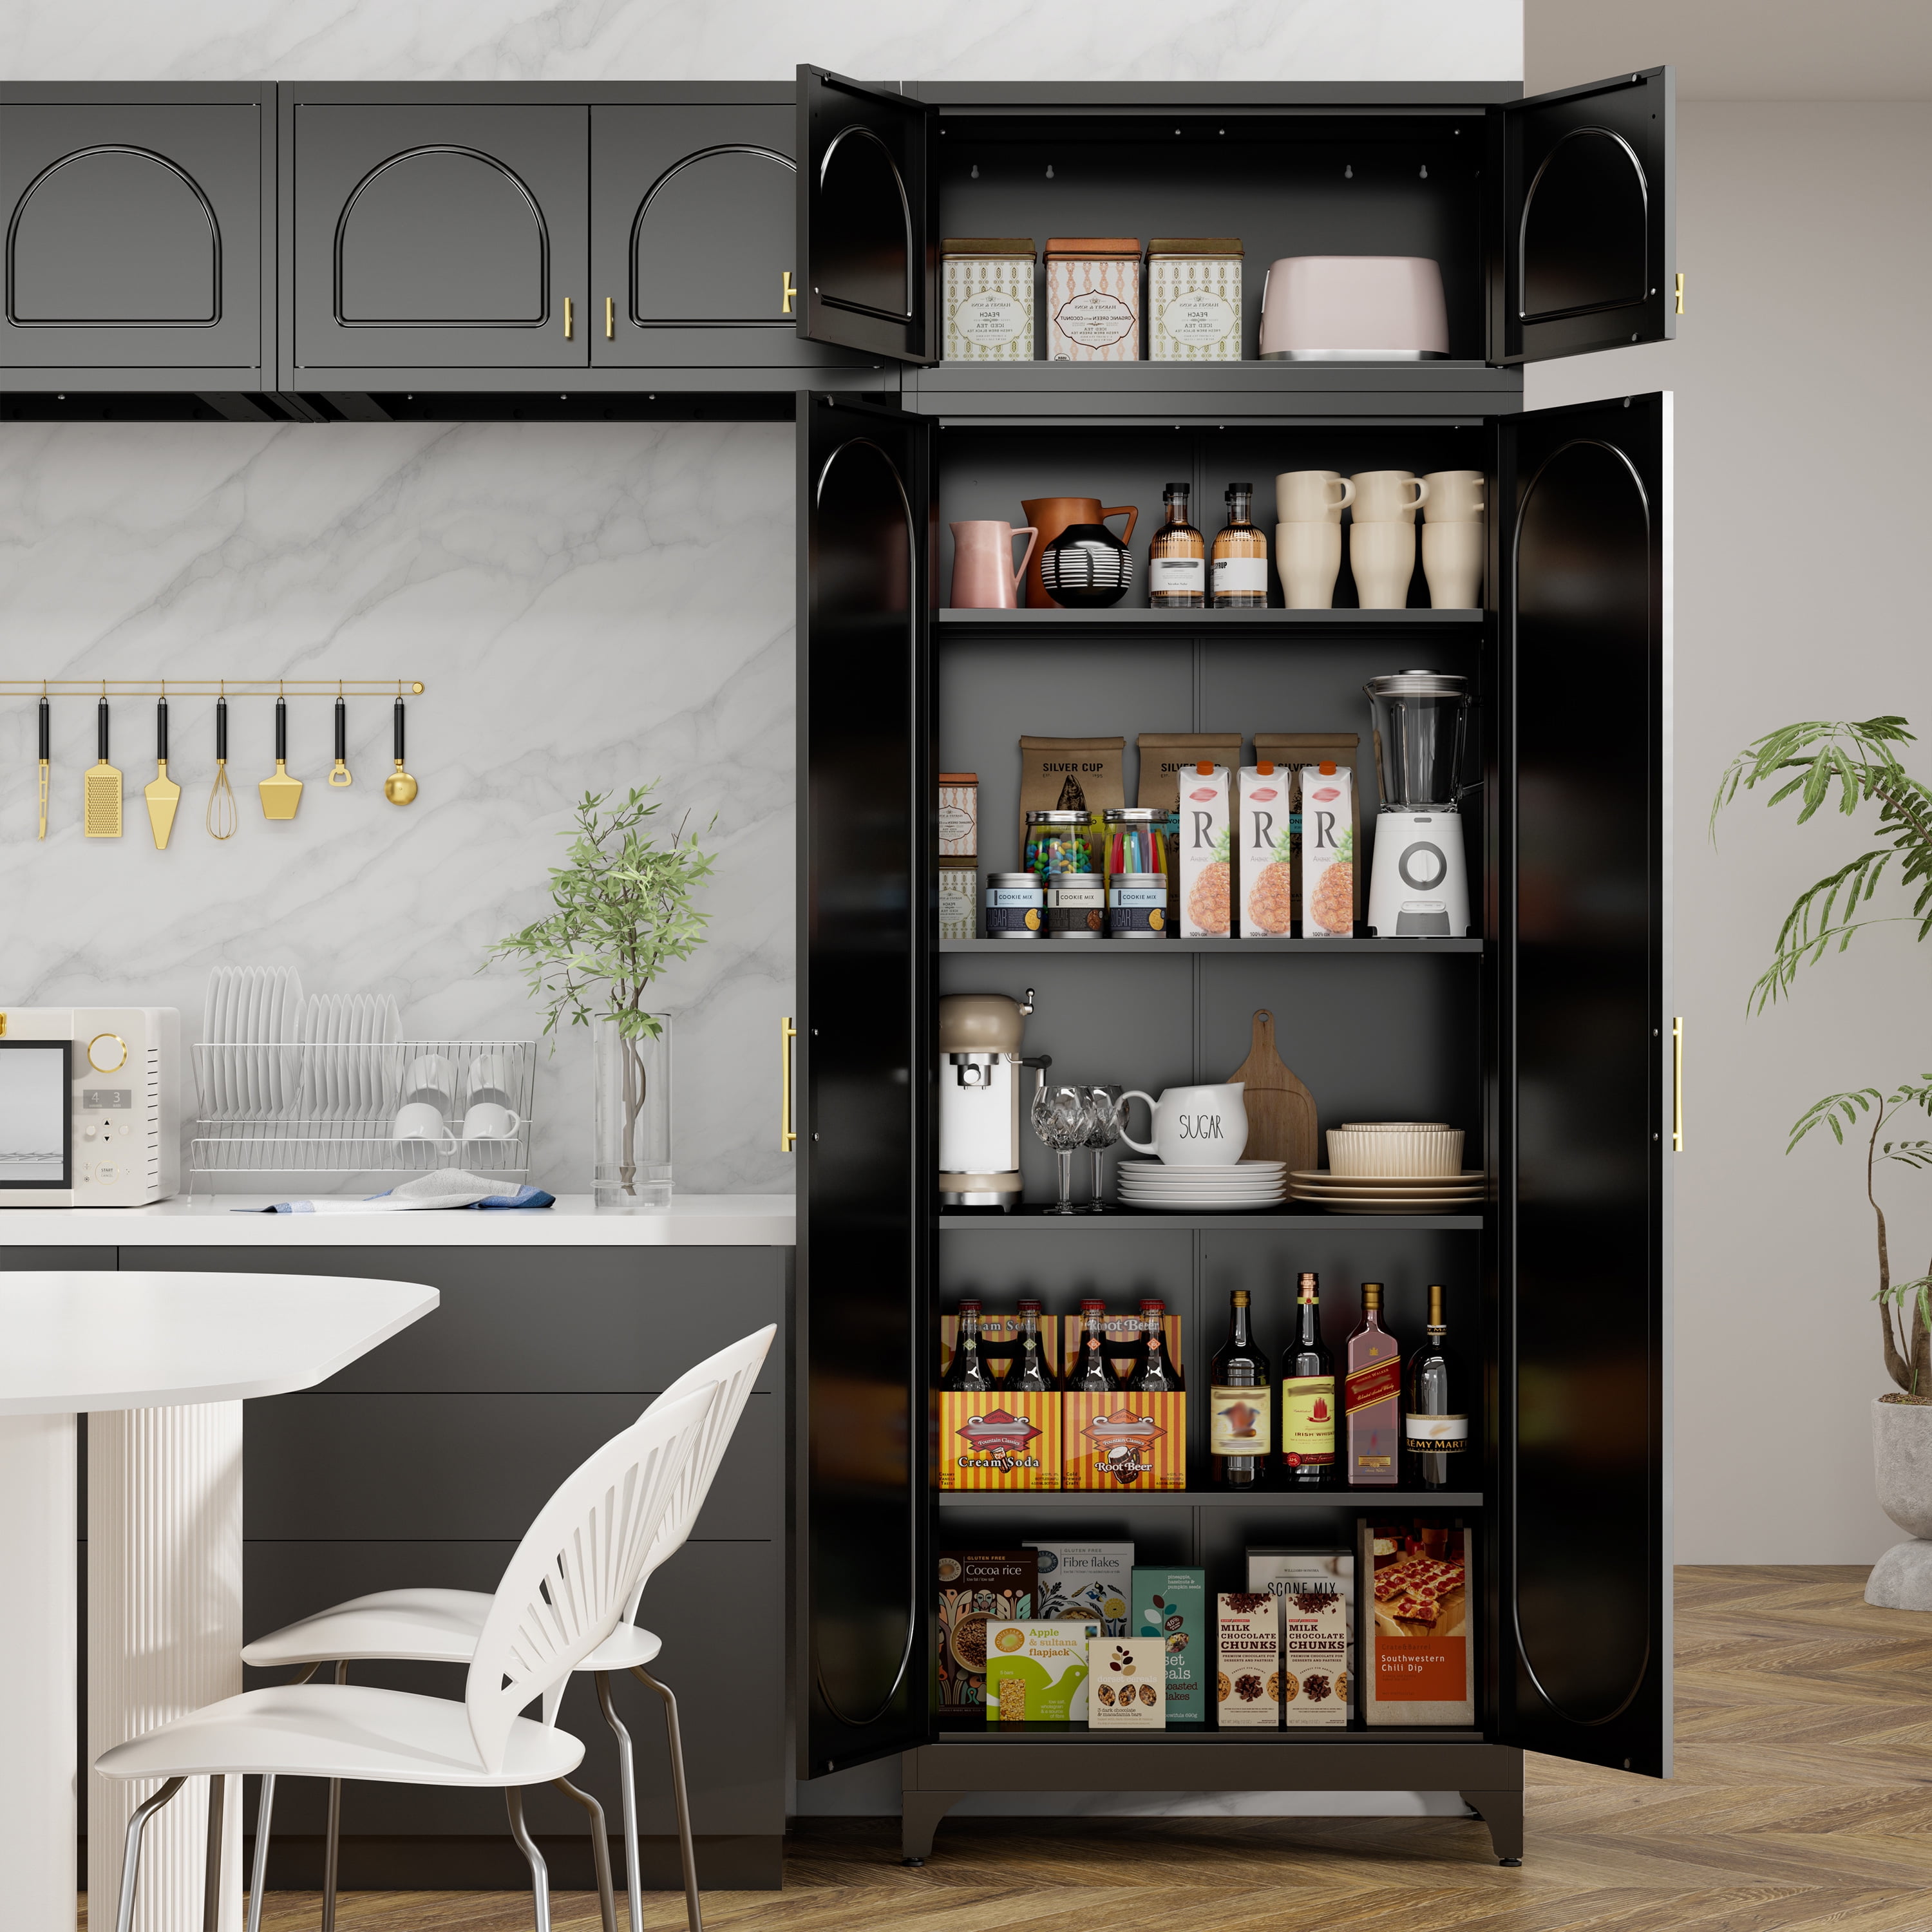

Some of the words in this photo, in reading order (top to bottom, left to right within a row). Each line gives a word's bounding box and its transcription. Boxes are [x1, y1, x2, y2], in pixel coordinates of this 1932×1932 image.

[1043, 763, 1078, 772] SILVER
[1082, 763, 1103, 772] CUP
[1191, 811, 1216, 848] R
[1252, 811, 1276, 848] R
[1314, 811, 1340, 848] R
[91, 1092, 99, 1103] 4
[113, 1092, 120, 1103] 3
[1179, 1115, 1224, 1139] SUGAR
[1372, 1368, 1389, 1377] WALKER
[1001, 1437, 1021, 1446] Classics
[1126, 1437, 1145, 1446] Classics
[958, 1457, 1001, 1467] Cream
[1007, 1457, 1039, 1467] Soda
[1095, 1462, 1124, 1472] Root
[1124, 1462, 1153, 1472] Beer
[1063, 1557, 1088, 1567] Fibre
[1091, 1557, 1119, 1567] flakes
[966, 1565, 999, 1575] Cocoa
[1003, 1565, 1021, 1575] rice
[1314, 1582, 1336, 1594] MIX
[1029, 1629, 1059, 1638] Apple
[1221, 1641, 1276, 1649] CHUNKS
[1289, 1641, 1344, 1649] CHUNKS
[1029, 1649, 1070, 1658] flapjack
[1408, 1664, 1423, 1673] Dip
